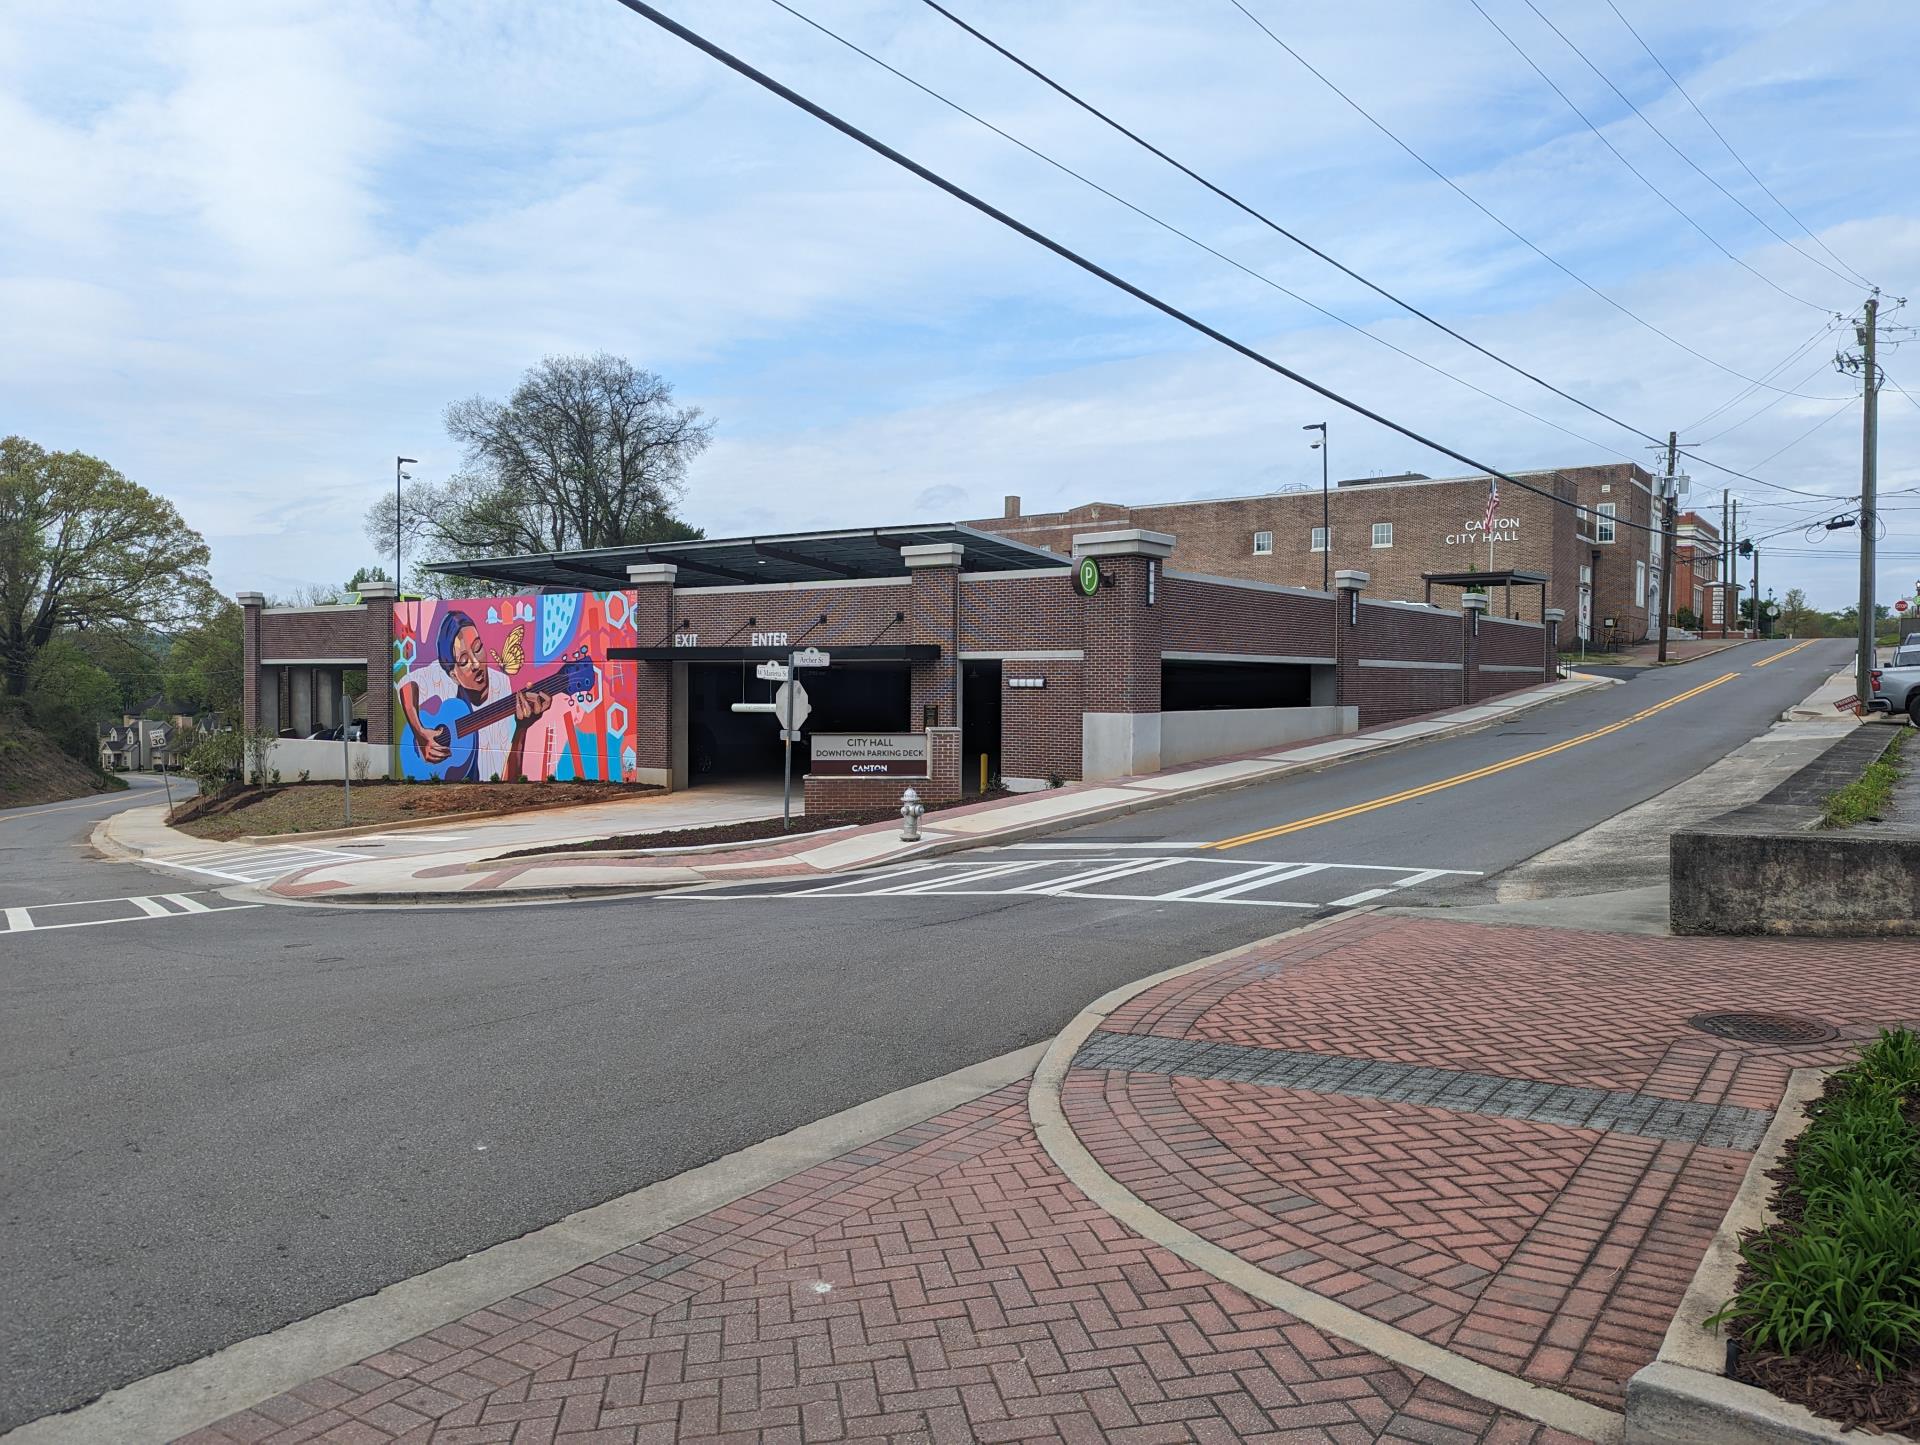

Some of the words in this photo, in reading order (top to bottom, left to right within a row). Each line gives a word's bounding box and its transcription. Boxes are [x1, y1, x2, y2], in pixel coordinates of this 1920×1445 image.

[1446, 533, 1476, 545] CITY
[1482, 531, 1519, 542] HALL
[1086, 567, 1092, 585] P
[674, 634, 698, 648] EXIT
[751, 632, 788, 647] ENTER
[799, 656, 817, 664] Archer
[847, 738, 868, 747] CITY
[870, 738, 893, 747] HALL
[816, 750, 866, 758] DOWNTOWN
[867, 749, 902, 757] PARKING
[903, 749, 924, 757] DECK
[852, 764, 888, 772] CANTON
